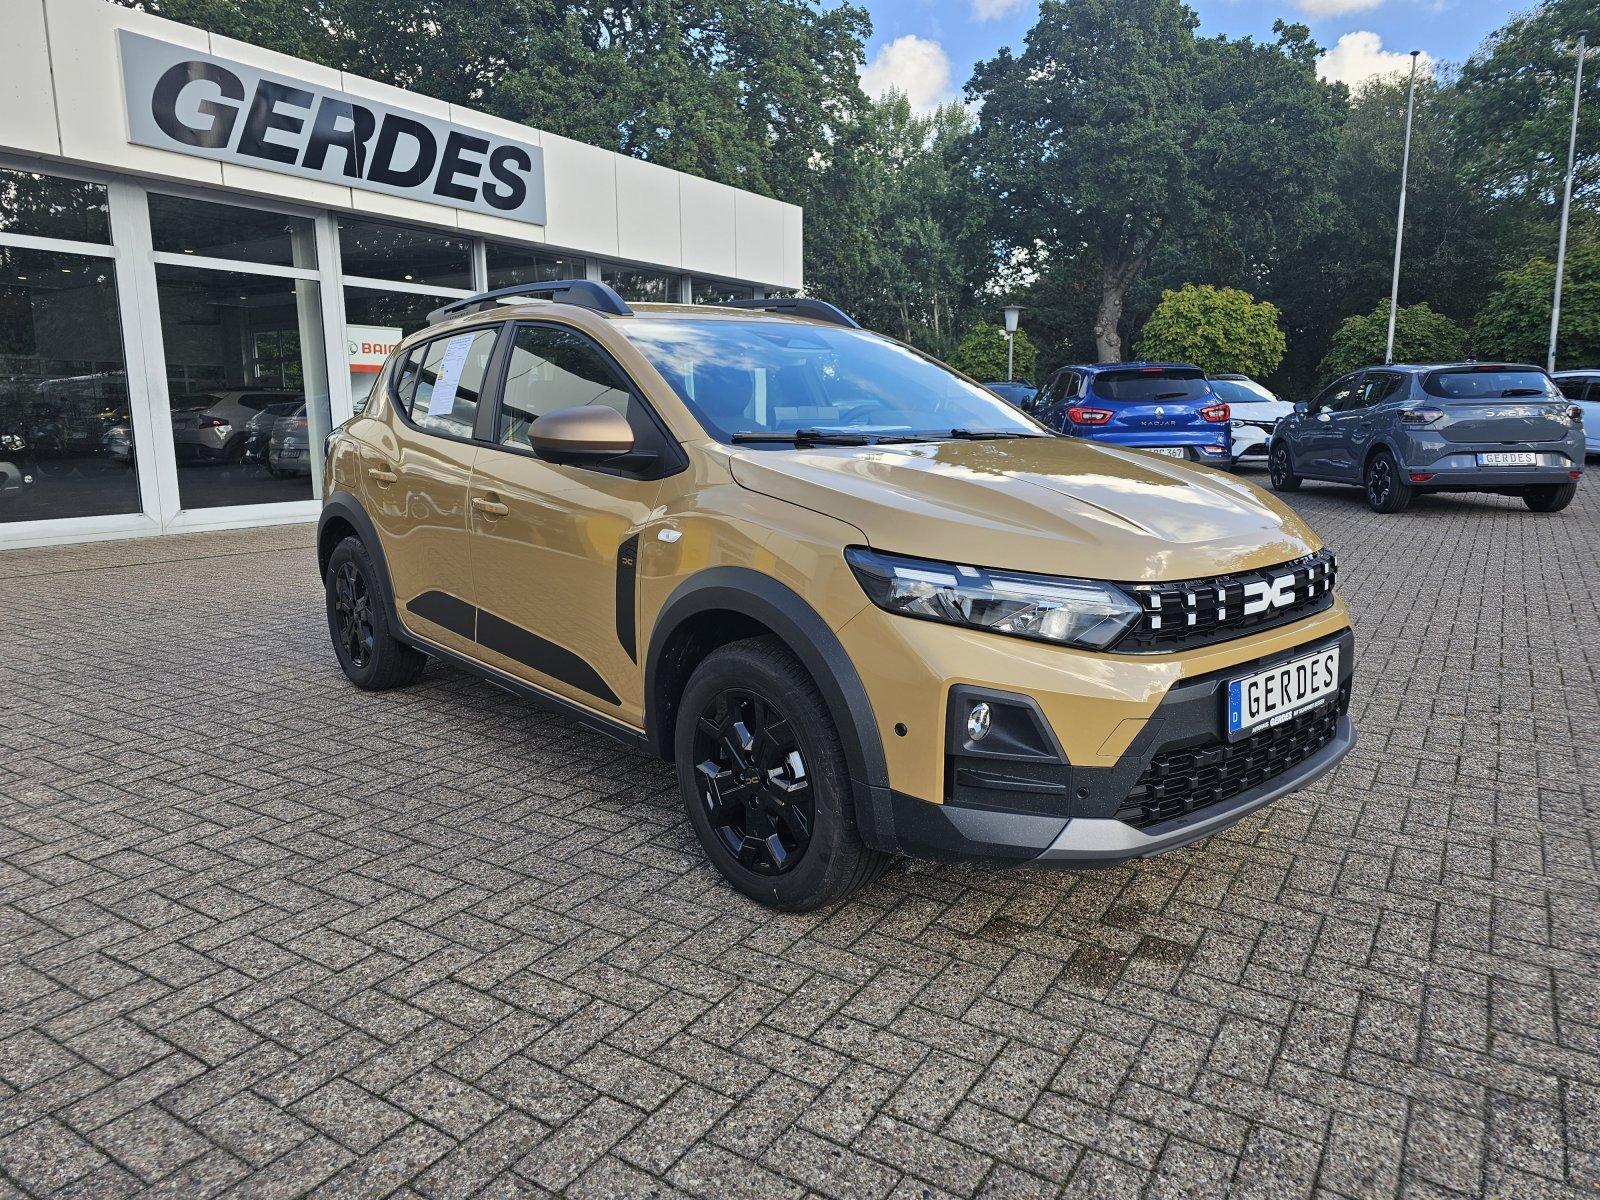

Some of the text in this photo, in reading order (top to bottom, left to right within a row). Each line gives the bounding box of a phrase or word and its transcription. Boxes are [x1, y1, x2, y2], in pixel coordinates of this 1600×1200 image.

[152, 60, 531, 210] GERDES
[1486, 453, 1532, 463] GERDES
[1232, 711, 1238, 723] D
[1247, 654, 1334, 719] GERDES
